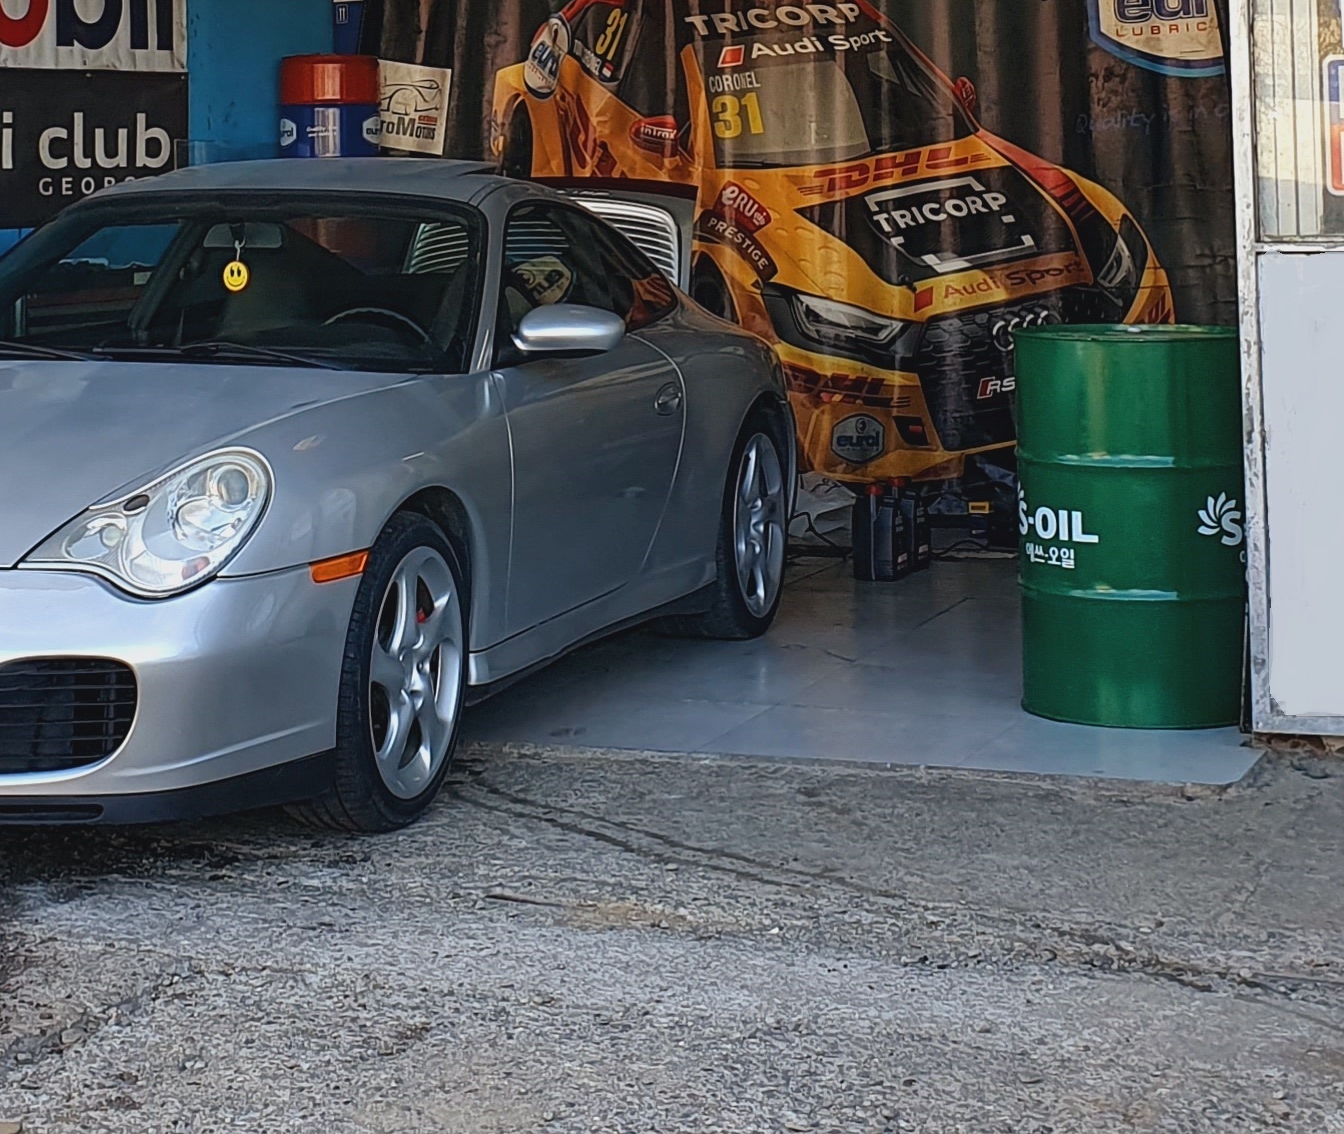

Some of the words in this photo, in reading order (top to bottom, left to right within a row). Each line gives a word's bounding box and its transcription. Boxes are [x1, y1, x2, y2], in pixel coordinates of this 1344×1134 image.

[596, 8, 628, 61] 31
[684, 3, 860, 36] TRICORP
[1115, 21, 1208, 38] LUBRIC
[750, 37, 825, 60] Audi
[828, 29, 893, 52] Sport
[708, 70, 761, 94] CORONEL
[712, 92, 765, 139] 31
[38, 111, 172, 170] club
[812, 146, 970, 193] DHL
[872, 191, 1008, 233] TRICORP
[707, 217, 769, 271] PRESTIGE
[943, 275, 1001, 300] Audi
[1006, 258, 1085, 287] Sport
[836, 430, 881, 448] eurol
